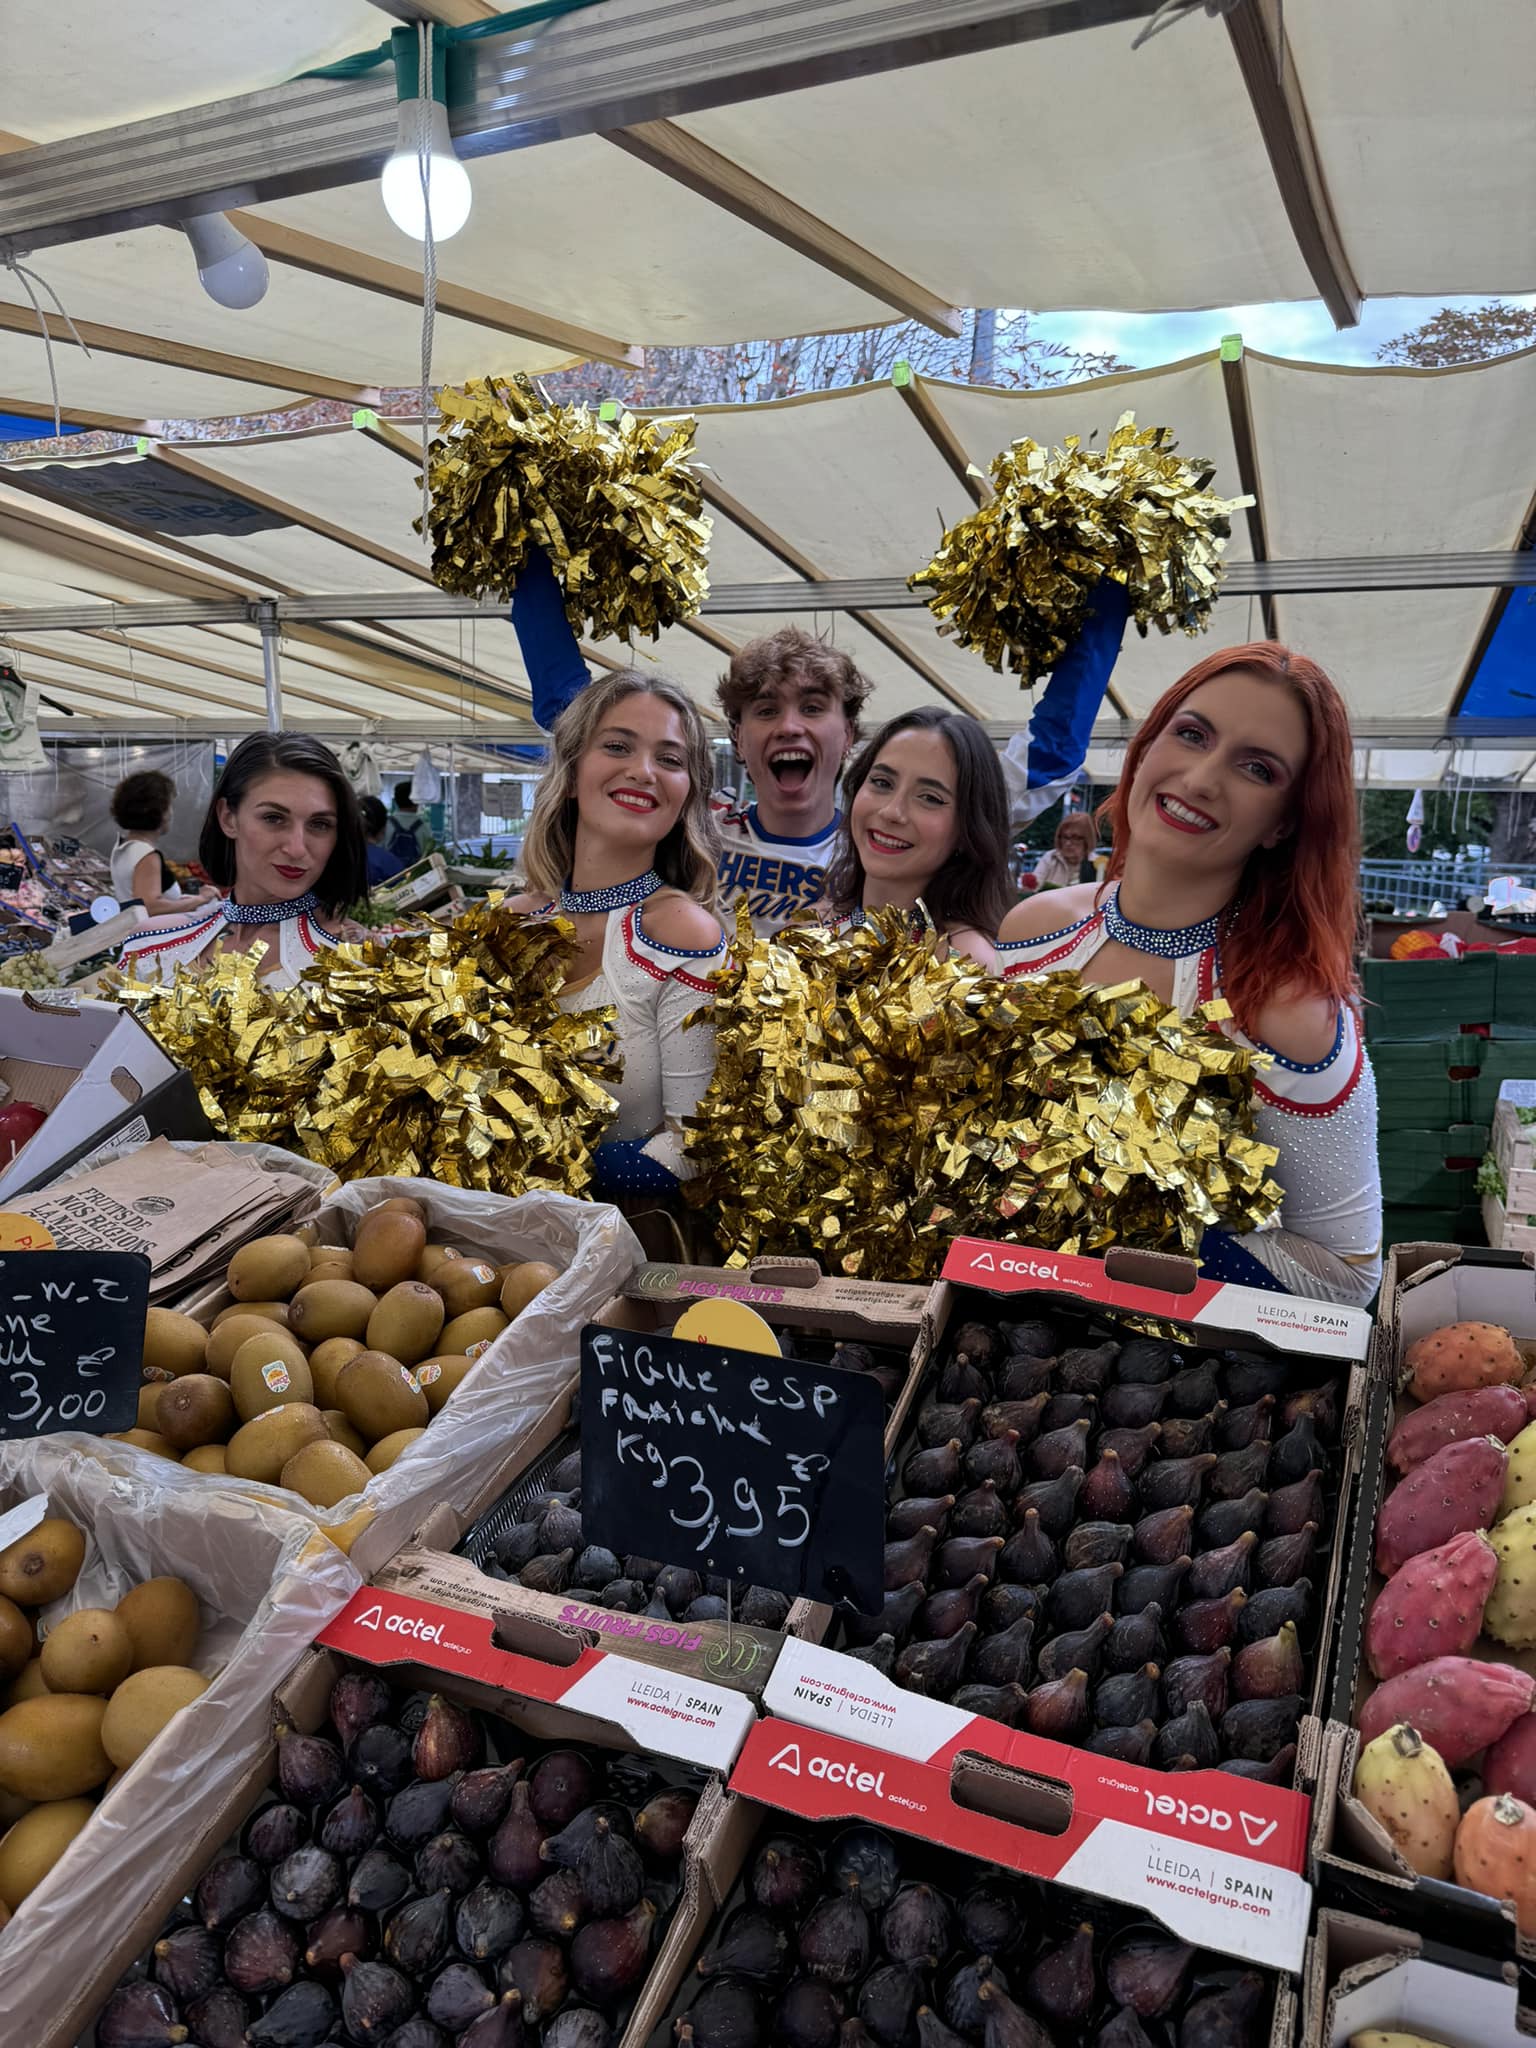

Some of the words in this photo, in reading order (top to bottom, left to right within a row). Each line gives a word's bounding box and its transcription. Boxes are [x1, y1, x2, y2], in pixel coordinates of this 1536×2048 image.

[718, 850, 825, 905] HEERS
[31, 1202, 59, 1219] LA
[53, 1195, 96, 1218] NOS
[78, 1187, 134, 1221] FRUITS
[122, 1214, 152, 1231] DE
[1000, 1260, 1059, 1281] actel
[678, 1280, 719, 1296] FIGS
[719, 1284, 785, 1303] FRUITS
[1256, 1316, 1348, 1337] www.actelgrup.com
[1257, 1305, 1297, 1320] LLEIDA
[1313, 1314, 1349, 1328] SPAIN
[8, 1371, 106, 1430] 3,00
[669, 1455, 810, 1551] 3,95
[429, 1577, 500, 1602] www.ecofigs.com
[385, 1612, 445, 1645] actel
[558, 1604, 645, 1638] FRUITS
[643, 1624, 703, 1651] FIGS
[631, 1681, 670, 1702] LLEIDA
[685, 1697, 723, 1716] SPAIN
[794, 1685, 833, 1707] SPAIN
[800, 1674, 897, 1714] www.actelgrup.com
[626, 1696, 716, 1728] www.actelgrup.com
[849, 1704, 894, 1729] LLEIDA
[807, 1755, 885, 1798] actel
[1097, 1776, 1139, 1793] actelgrup
[888, 1793, 928, 1813] actelgrup
[1144, 1790, 1233, 1831] actel
[1147, 1855, 1201, 1882] LLEIDA
[1224, 1877, 1273, 1902] SPAIN
[1146, 1874, 1271, 1917] www.actelgrup.com
